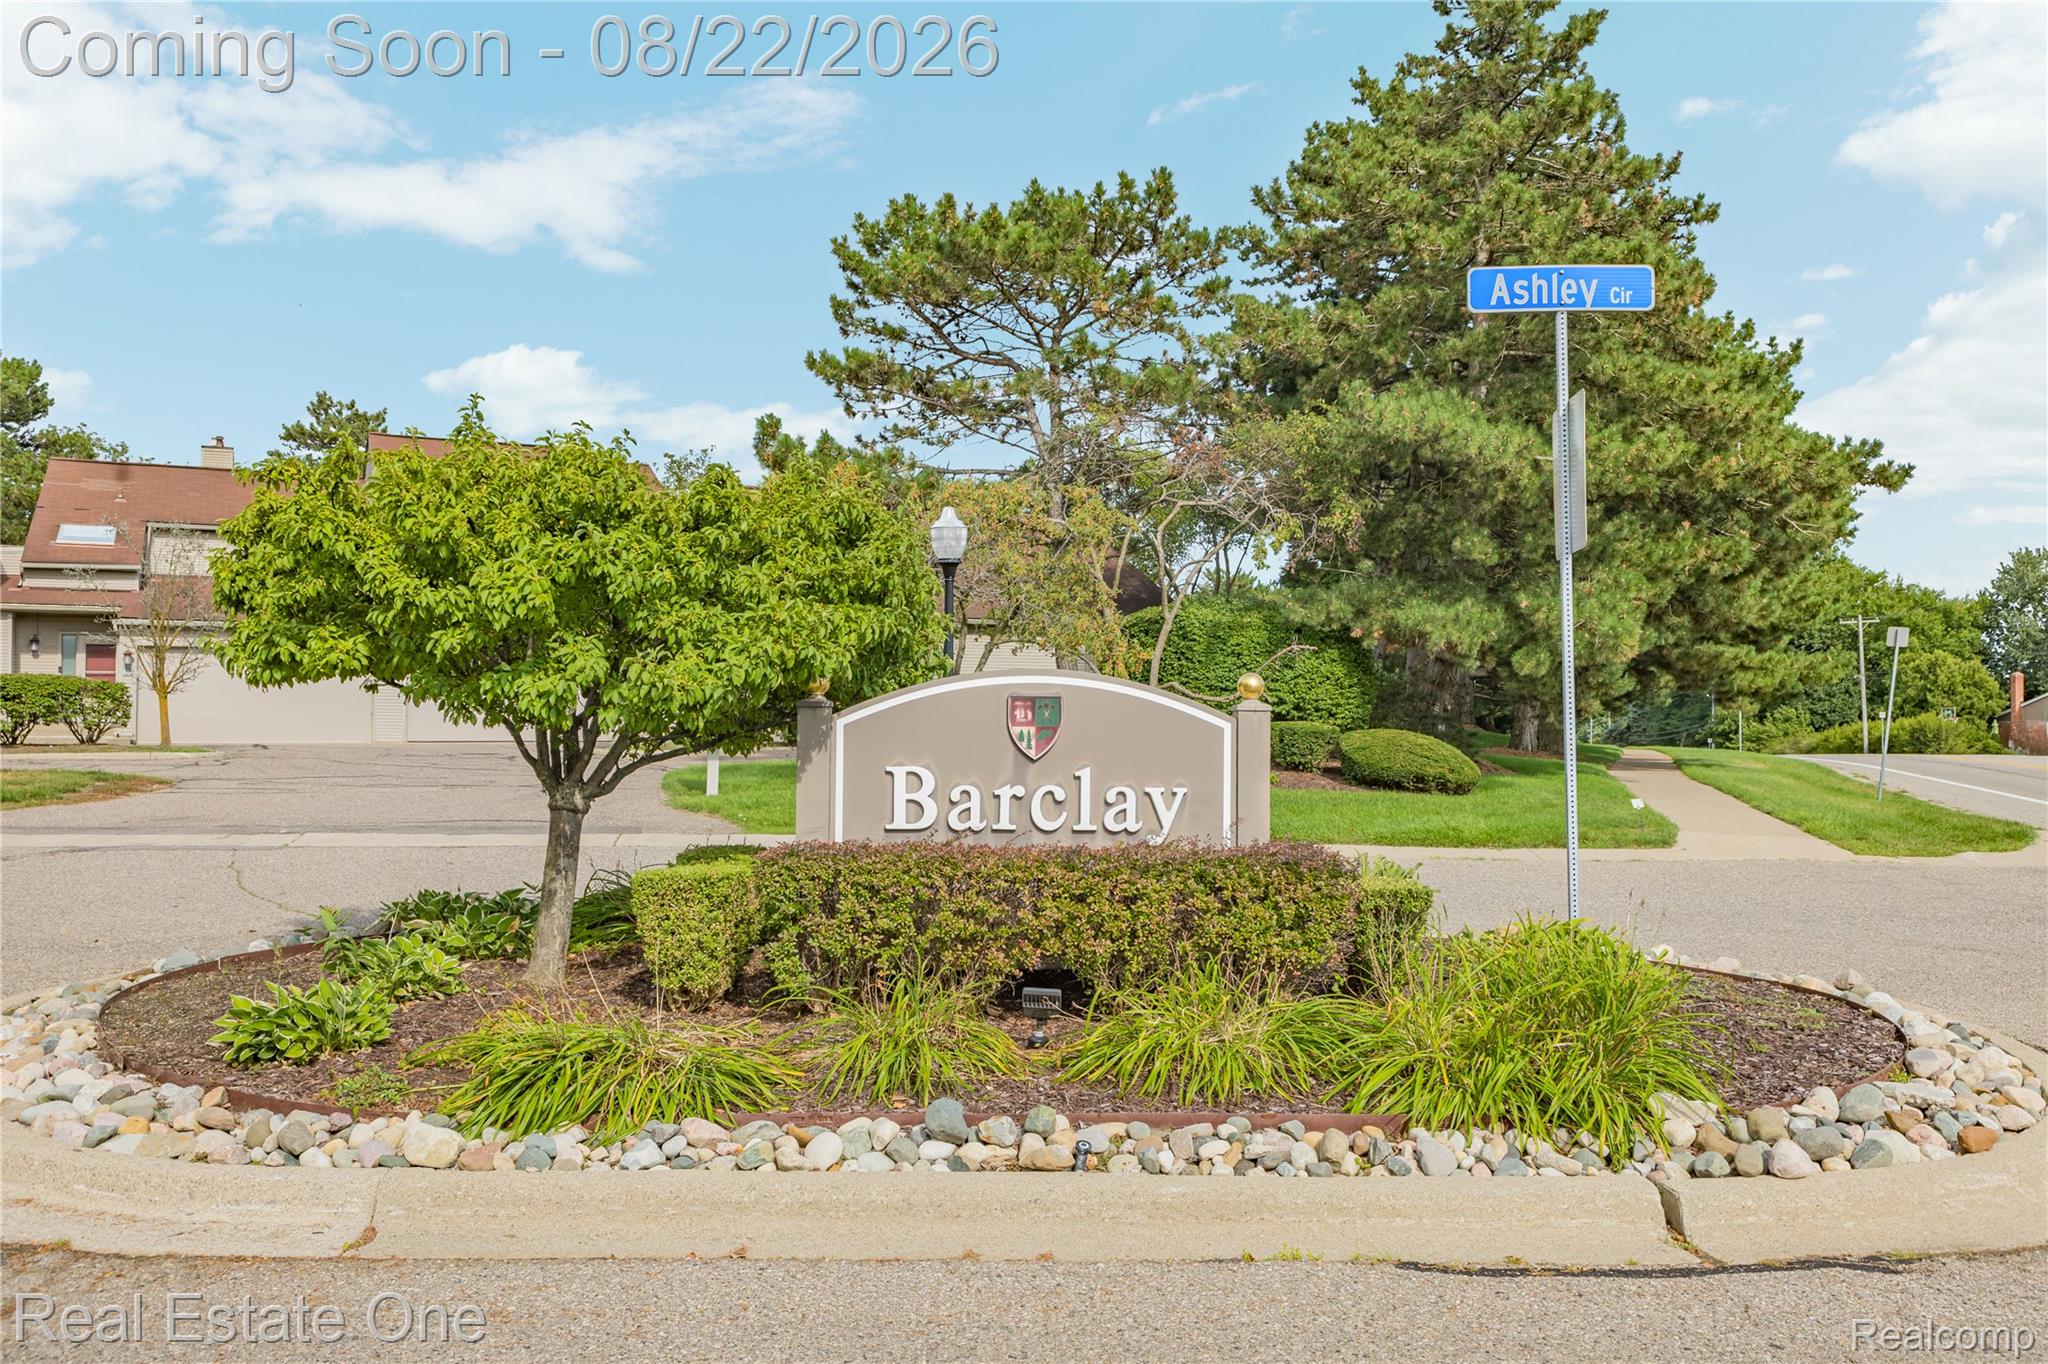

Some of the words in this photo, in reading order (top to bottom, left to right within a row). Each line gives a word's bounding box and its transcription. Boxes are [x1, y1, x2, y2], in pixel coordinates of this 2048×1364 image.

[1490, 272, 1598, 309] Ashley
[1610, 287, 1633, 304] Cir
[884, 765, 1188, 846] Barclay
